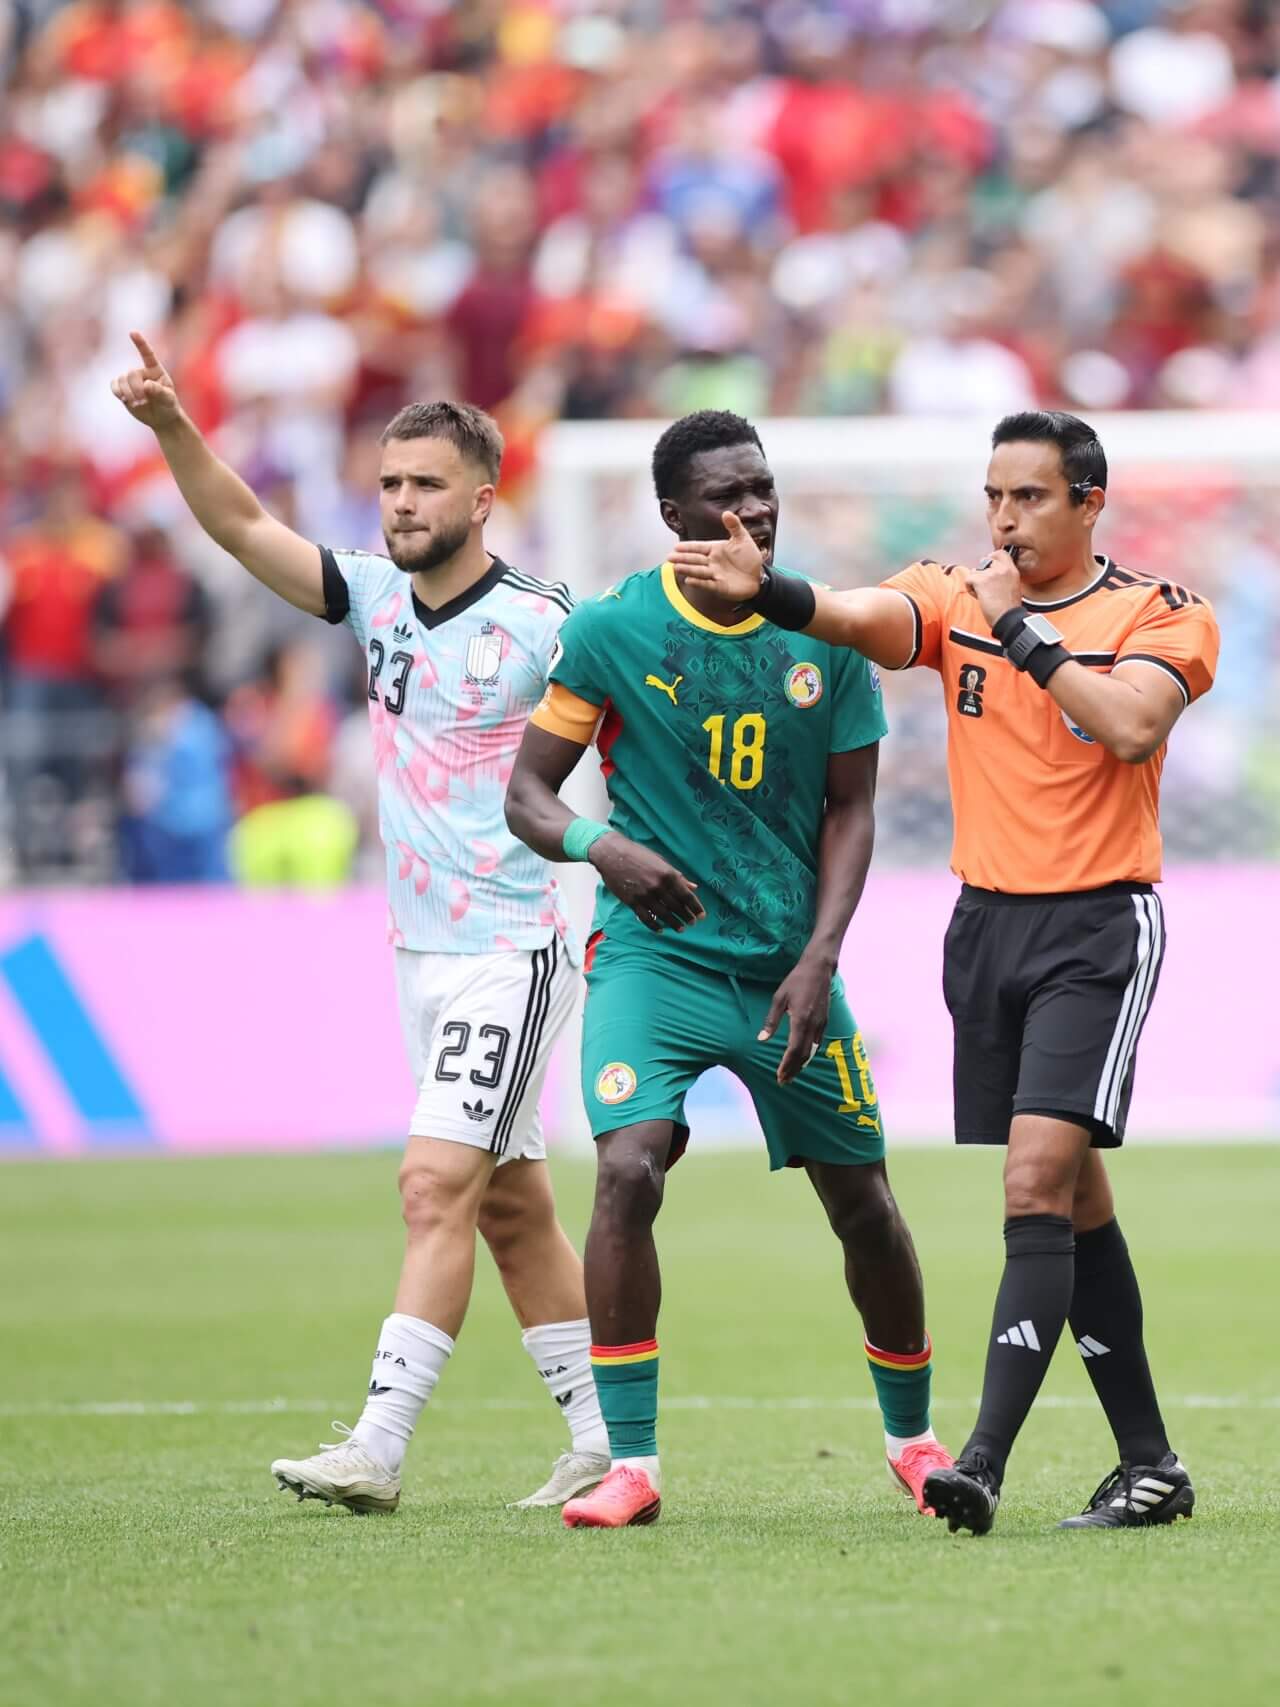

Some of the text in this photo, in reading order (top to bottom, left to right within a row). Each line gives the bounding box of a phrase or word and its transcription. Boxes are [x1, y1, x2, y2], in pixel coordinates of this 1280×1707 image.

[367, 637, 415, 716] 23
[701, 712, 767, 791] 18
[434, 1020, 511, 1089] 23
[825, 1031, 877, 1113] 18
